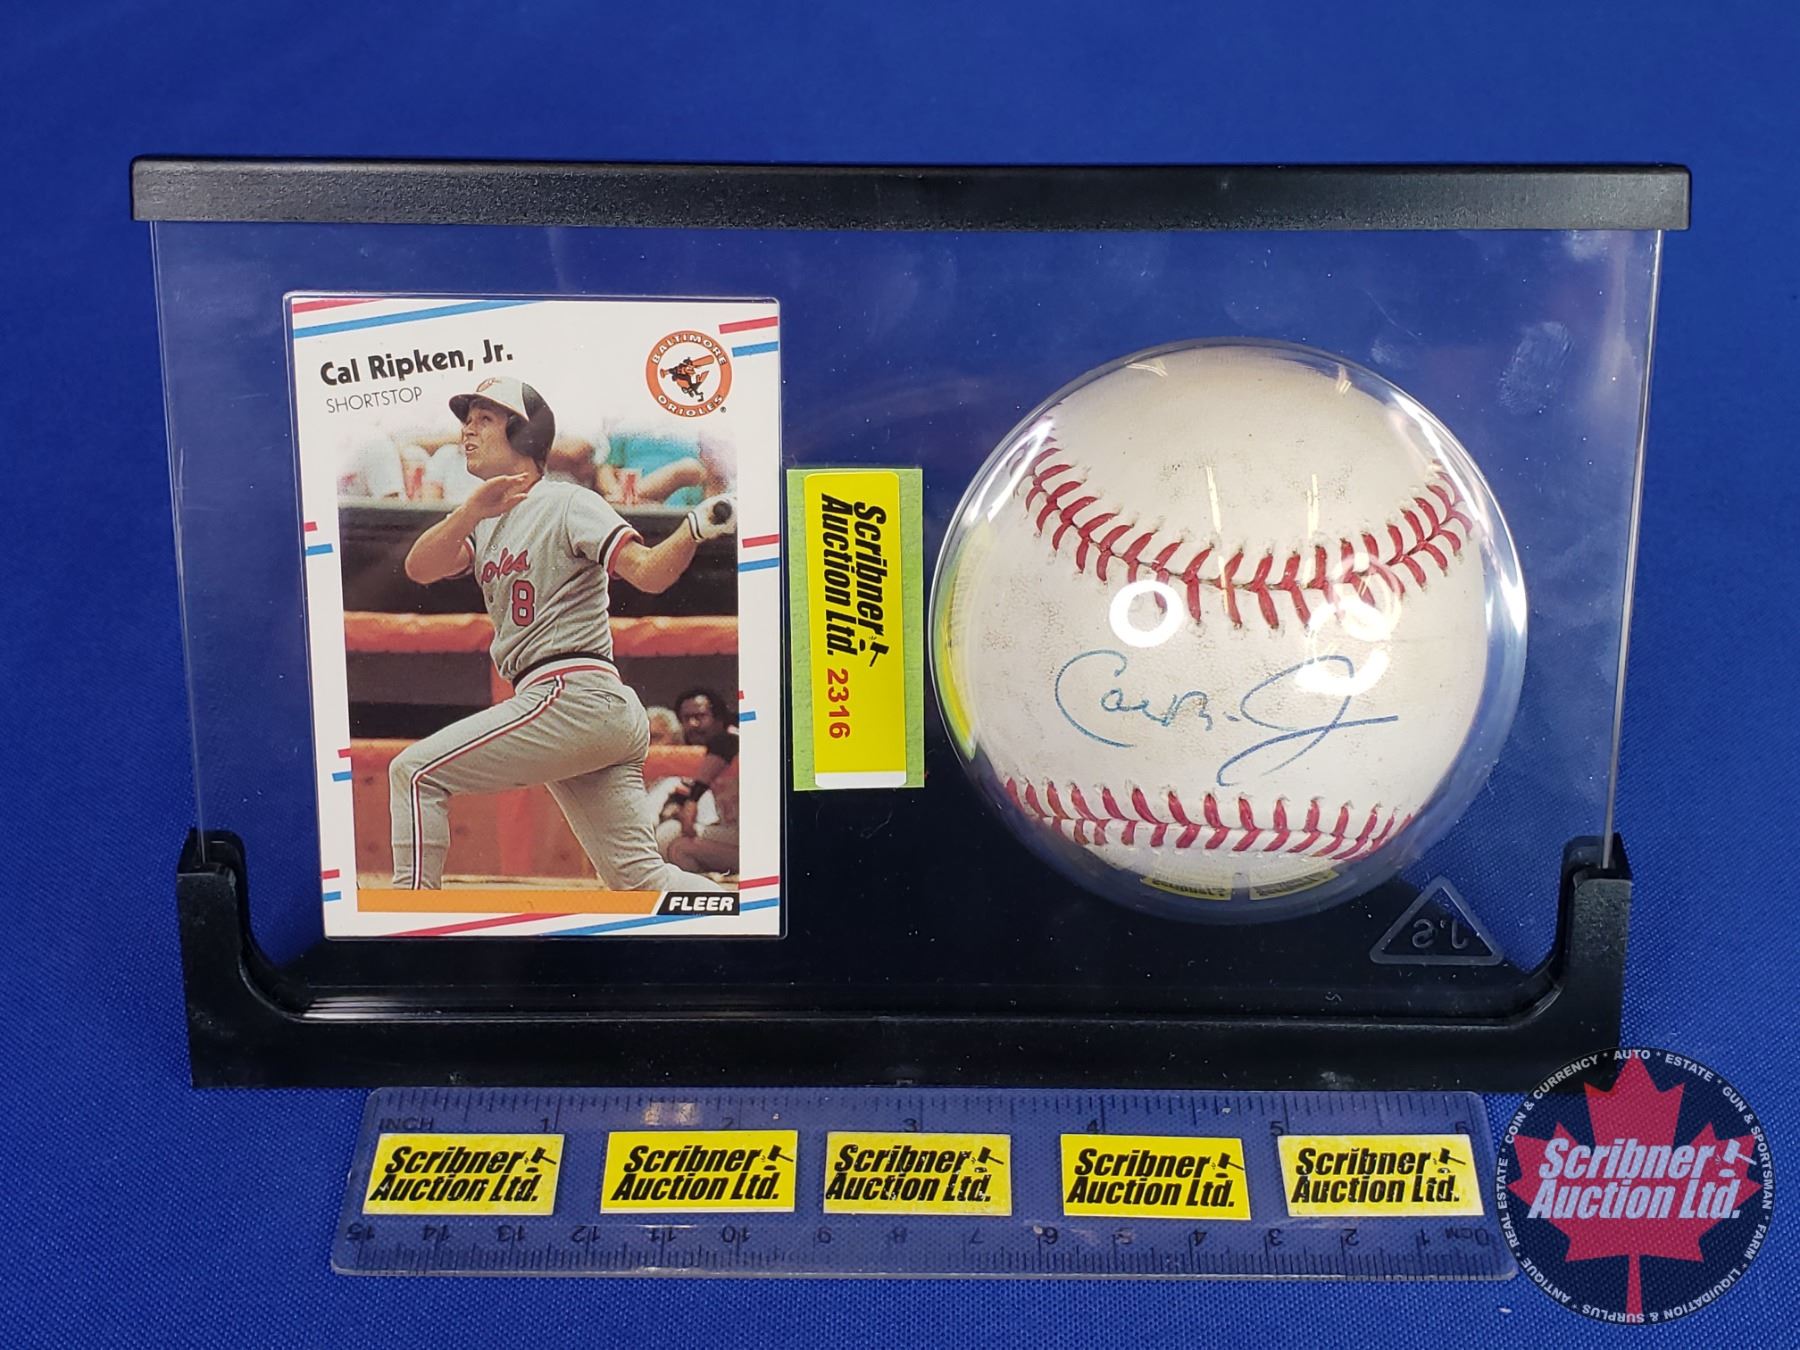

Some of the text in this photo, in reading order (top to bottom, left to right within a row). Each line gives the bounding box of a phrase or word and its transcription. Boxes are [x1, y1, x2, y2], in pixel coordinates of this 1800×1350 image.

[320, 339, 513, 386] Cal Ripken, Jr.
[652, 334, 727, 366] BALTIMORE
[326, 386, 423, 414] SHORTSTOP
[658, 395, 723, 417] ORIOLES
[853, 501, 888, 638] Scribner
[512, 579, 536, 627] 8
[821, 492, 858, 740] Auction Ltd. 2316
[668, 895, 735, 913] FLEER
[379, 1117, 434, 1131] INCH
[385, 1145, 526, 1174] Scribner
[623, 1144, 763, 1173] Scribner
[834, 1144, 971, 1173] Scribner
[1074, 1148, 1210, 1178] Scribner
[1295, 1147, 1431, 1175] Scribner
[368, 1174, 543, 1202] Auction Ltd.
[610, 1172, 780, 1200] Auction Ltd.
[825, 1173, 992, 1202] Auction Ltd.
[1066, 1176, 1236, 1207] Auction Ltd.
[1291, 1175, 1461, 1204] Auction Ltd.
[571, 1225, 601, 1243] 12
[721, 1225, 749, 1243] 10
[1269, 1228, 1284, 1247] 3
[1344, 1228, 1359, 1247] 2
